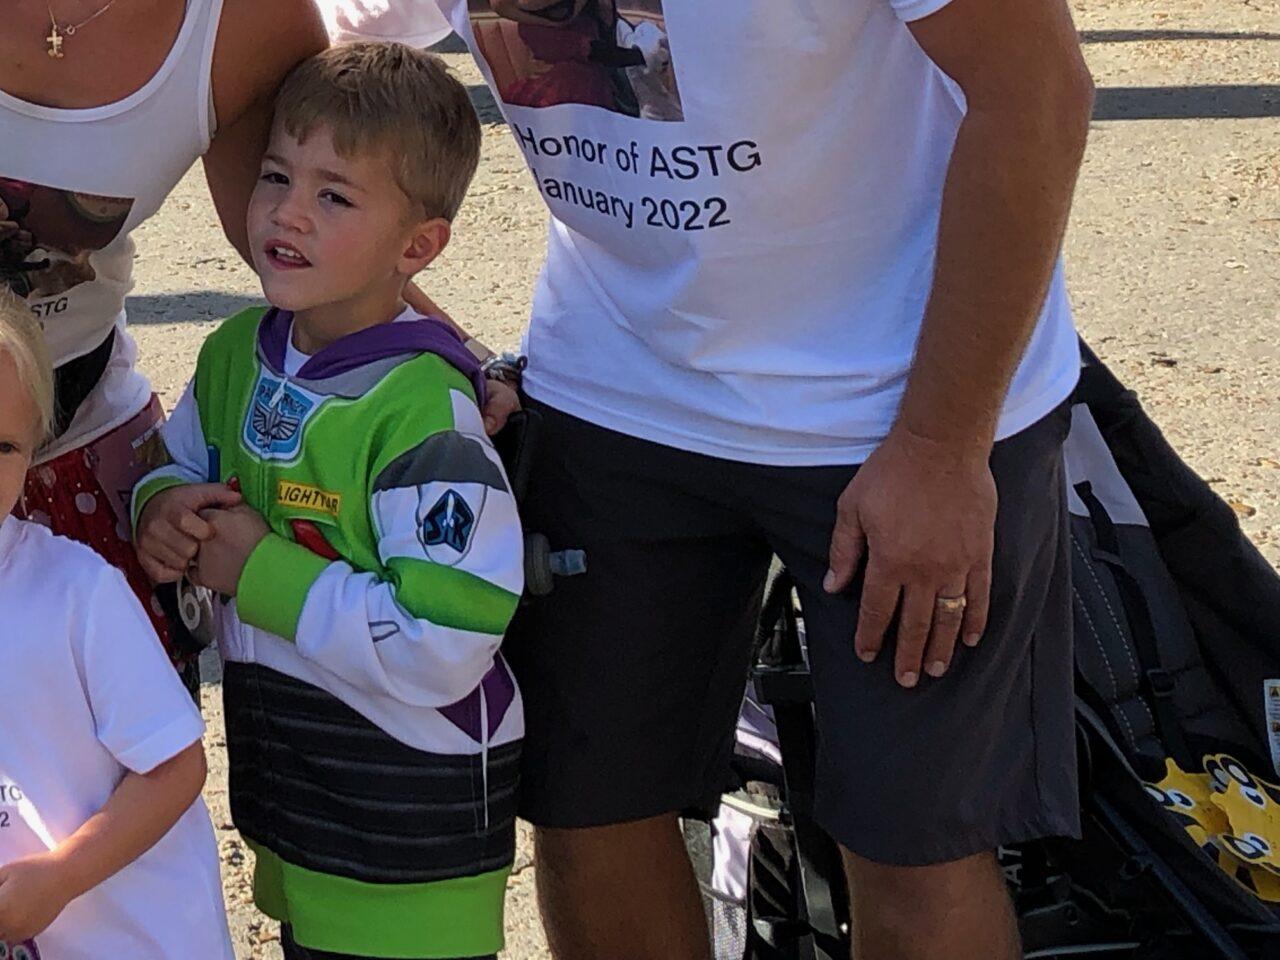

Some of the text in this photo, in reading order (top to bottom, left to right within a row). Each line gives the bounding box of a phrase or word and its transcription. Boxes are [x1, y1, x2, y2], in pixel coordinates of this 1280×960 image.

[513, 123, 762, 180] Honor of ASTG
[641, 196, 731, 231] 2022
